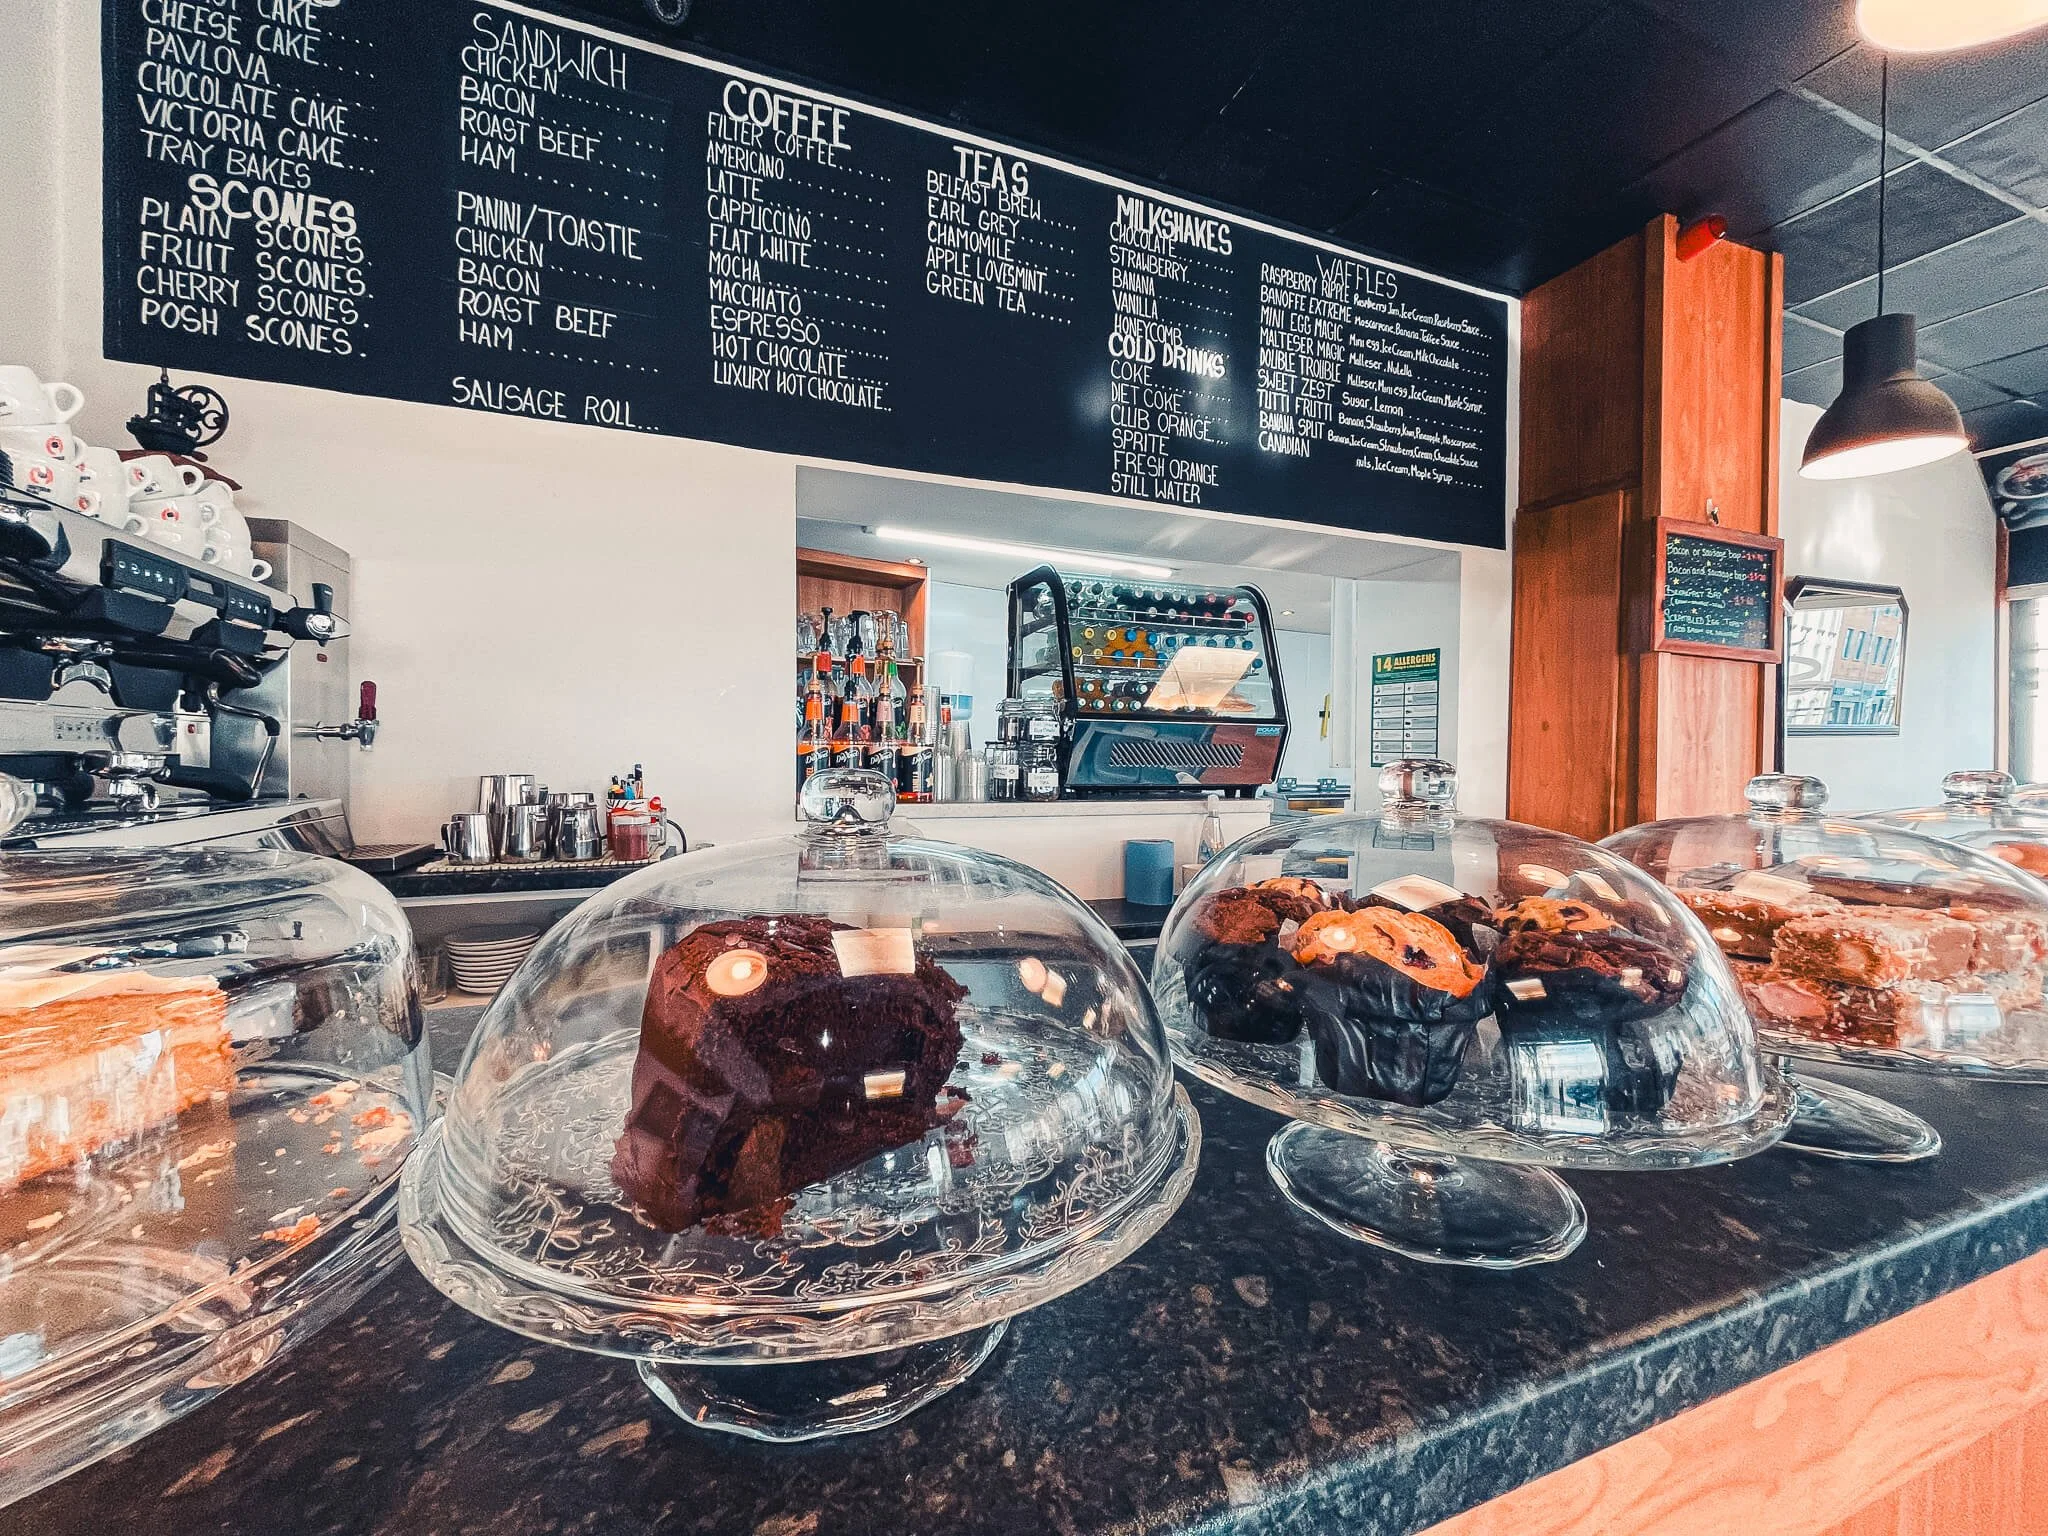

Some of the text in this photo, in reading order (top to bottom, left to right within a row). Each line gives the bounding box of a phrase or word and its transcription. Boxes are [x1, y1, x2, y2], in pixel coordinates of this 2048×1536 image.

[142, 0, 320, 65] CHEESE CAKE
[257, 0, 321, 32] CAKE
[147, 27, 270, 84] PAVLOVA
[462, 46, 557, 94] CHICKEN
[473, 13, 626, 90] SANDWICH
[138, 61, 348, 136] CHOCOLATE CAKE
[461, 76, 535, 118] BACON
[723, 80, 851, 150] COFFEE
[137, 94, 344, 167] VICTORIA CAKE
[460, 107, 600, 160] ROAST BEEF
[708, 112, 836, 167] FILTER COFFEE
[140, 129, 311, 189] TRAY BAKES
[462, 136, 515, 173] HAM
[707, 140, 784, 179] AMERICANO
[953, 145, 1028, 196] TEAS
[708, 167, 763, 202] LATTE
[927, 169, 1040, 220] BELFAST BREW
[188, 173, 356, 237] SCONES
[708, 195, 810, 240] CAPPUCCINO
[928, 196, 1019, 238] EARL GREY
[1117, 194, 1232, 255] MILKSHAKES
[141, 197, 365, 263] PLAIN SCONES
[458, 191, 642, 260] PANINI/TOASTIE
[710, 223, 811, 268] FLAT WHITE
[928, 220, 1015, 262] CHAMOMILE
[1110, 221, 1177, 258] CHOCOLATE
[141, 231, 366, 296] FRUIT SCONES
[456, 227, 543, 267] CHICKEN
[709, 250, 760, 283] MOCHA
[926, 245, 971, 277] APPLE
[1110, 245, 1188, 282] STRAWBERRY
[137, 266, 358, 324] CHERRY SCONES
[458, 258, 540, 296] BACON
[710, 277, 801, 316] MACCHIATO
[926, 271, 1026, 313] GREEN TEA
[1113, 267, 1155, 296] BANANA
[1261, 262, 1317, 295] RASPBERRY
[1321, 279, 1350, 304] RIPPLE
[1316, 254, 1397, 299] WAFFLES
[459, 288, 617, 338] ROAST BEEF
[1112, 289, 1158, 320] VANILLA
[1260, 285, 1307, 312] BANOFFE
[1309, 297, 1353, 323] EXTREME
[1260, 305, 1284, 329] MINI
[1290, 312, 1311, 335] EGG
[1314, 318, 1343, 342] MAGIC
[141, 298, 352, 355] POSH SCONES
[460, 319, 512, 350] HAM
[711, 305, 820, 345] ESPRESSO
[1115, 313, 1182, 347] HONEYCOMB
[1260, 326, 1313, 356] MALTESER
[1317, 339, 1345, 363] MAGIC
[713, 332, 848, 379] HOT CHOCOLATE
[1108, 332, 1226, 378] COLD DRINKS
[1111, 359, 1152, 387] COKE
[1260, 347, 1296, 373] DOUBLE
[1299, 354, 1341, 383] TROUBLE
[714, 360, 770, 391] LUXURY
[1257, 368, 1298, 394] SWEET
[1301, 377, 1335, 400] ZEST
[1374, 396, 1404, 416] Lemon
[453, 377, 567, 418] SAUSAGE
[1111, 381, 1183, 414] DIET COKE
[1256, 388, 1290, 413] TUTTI
[1295, 397, 1332, 421] FRUTTI
[1111, 405, 1212, 442] CLUB ORANGE
[1113, 428, 1169, 456] SPRITE
[1259, 430, 1310, 457] CANADIAN
[1260, 410, 1295, 435] BANANA
[1298, 418, 1325, 439] SPLIT
[1112, 472, 1200, 504] STILL WATER
[1114, 450, 1219, 487] FRESH ORANGE
[1666, 543, 1690, 556] Bacon
[1667, 561, 1691, 575] Bacon
[1376, 657, 1392, 673] 14
[1394, 654, 1436, 666] ALLERGENS
